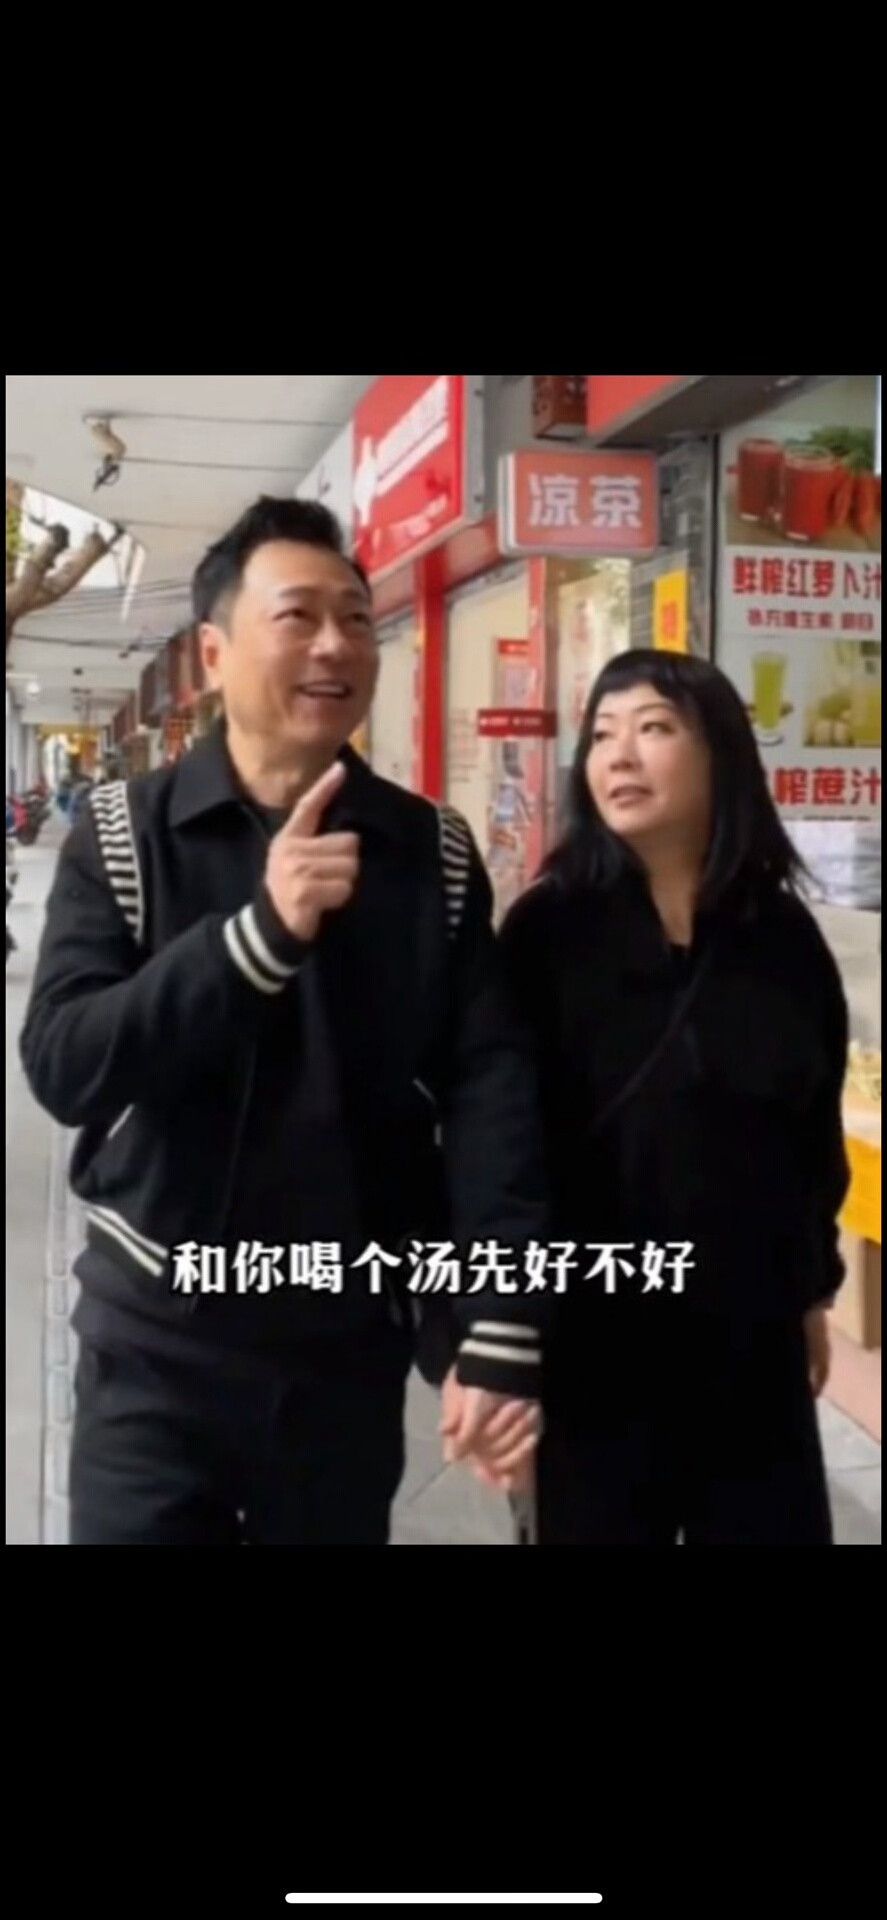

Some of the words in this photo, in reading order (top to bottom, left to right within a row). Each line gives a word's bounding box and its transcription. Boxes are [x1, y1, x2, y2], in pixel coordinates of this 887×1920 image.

[528, 473, 643, 528] 凉茶
[766, 767, 881, 805] 榨蔗汁
